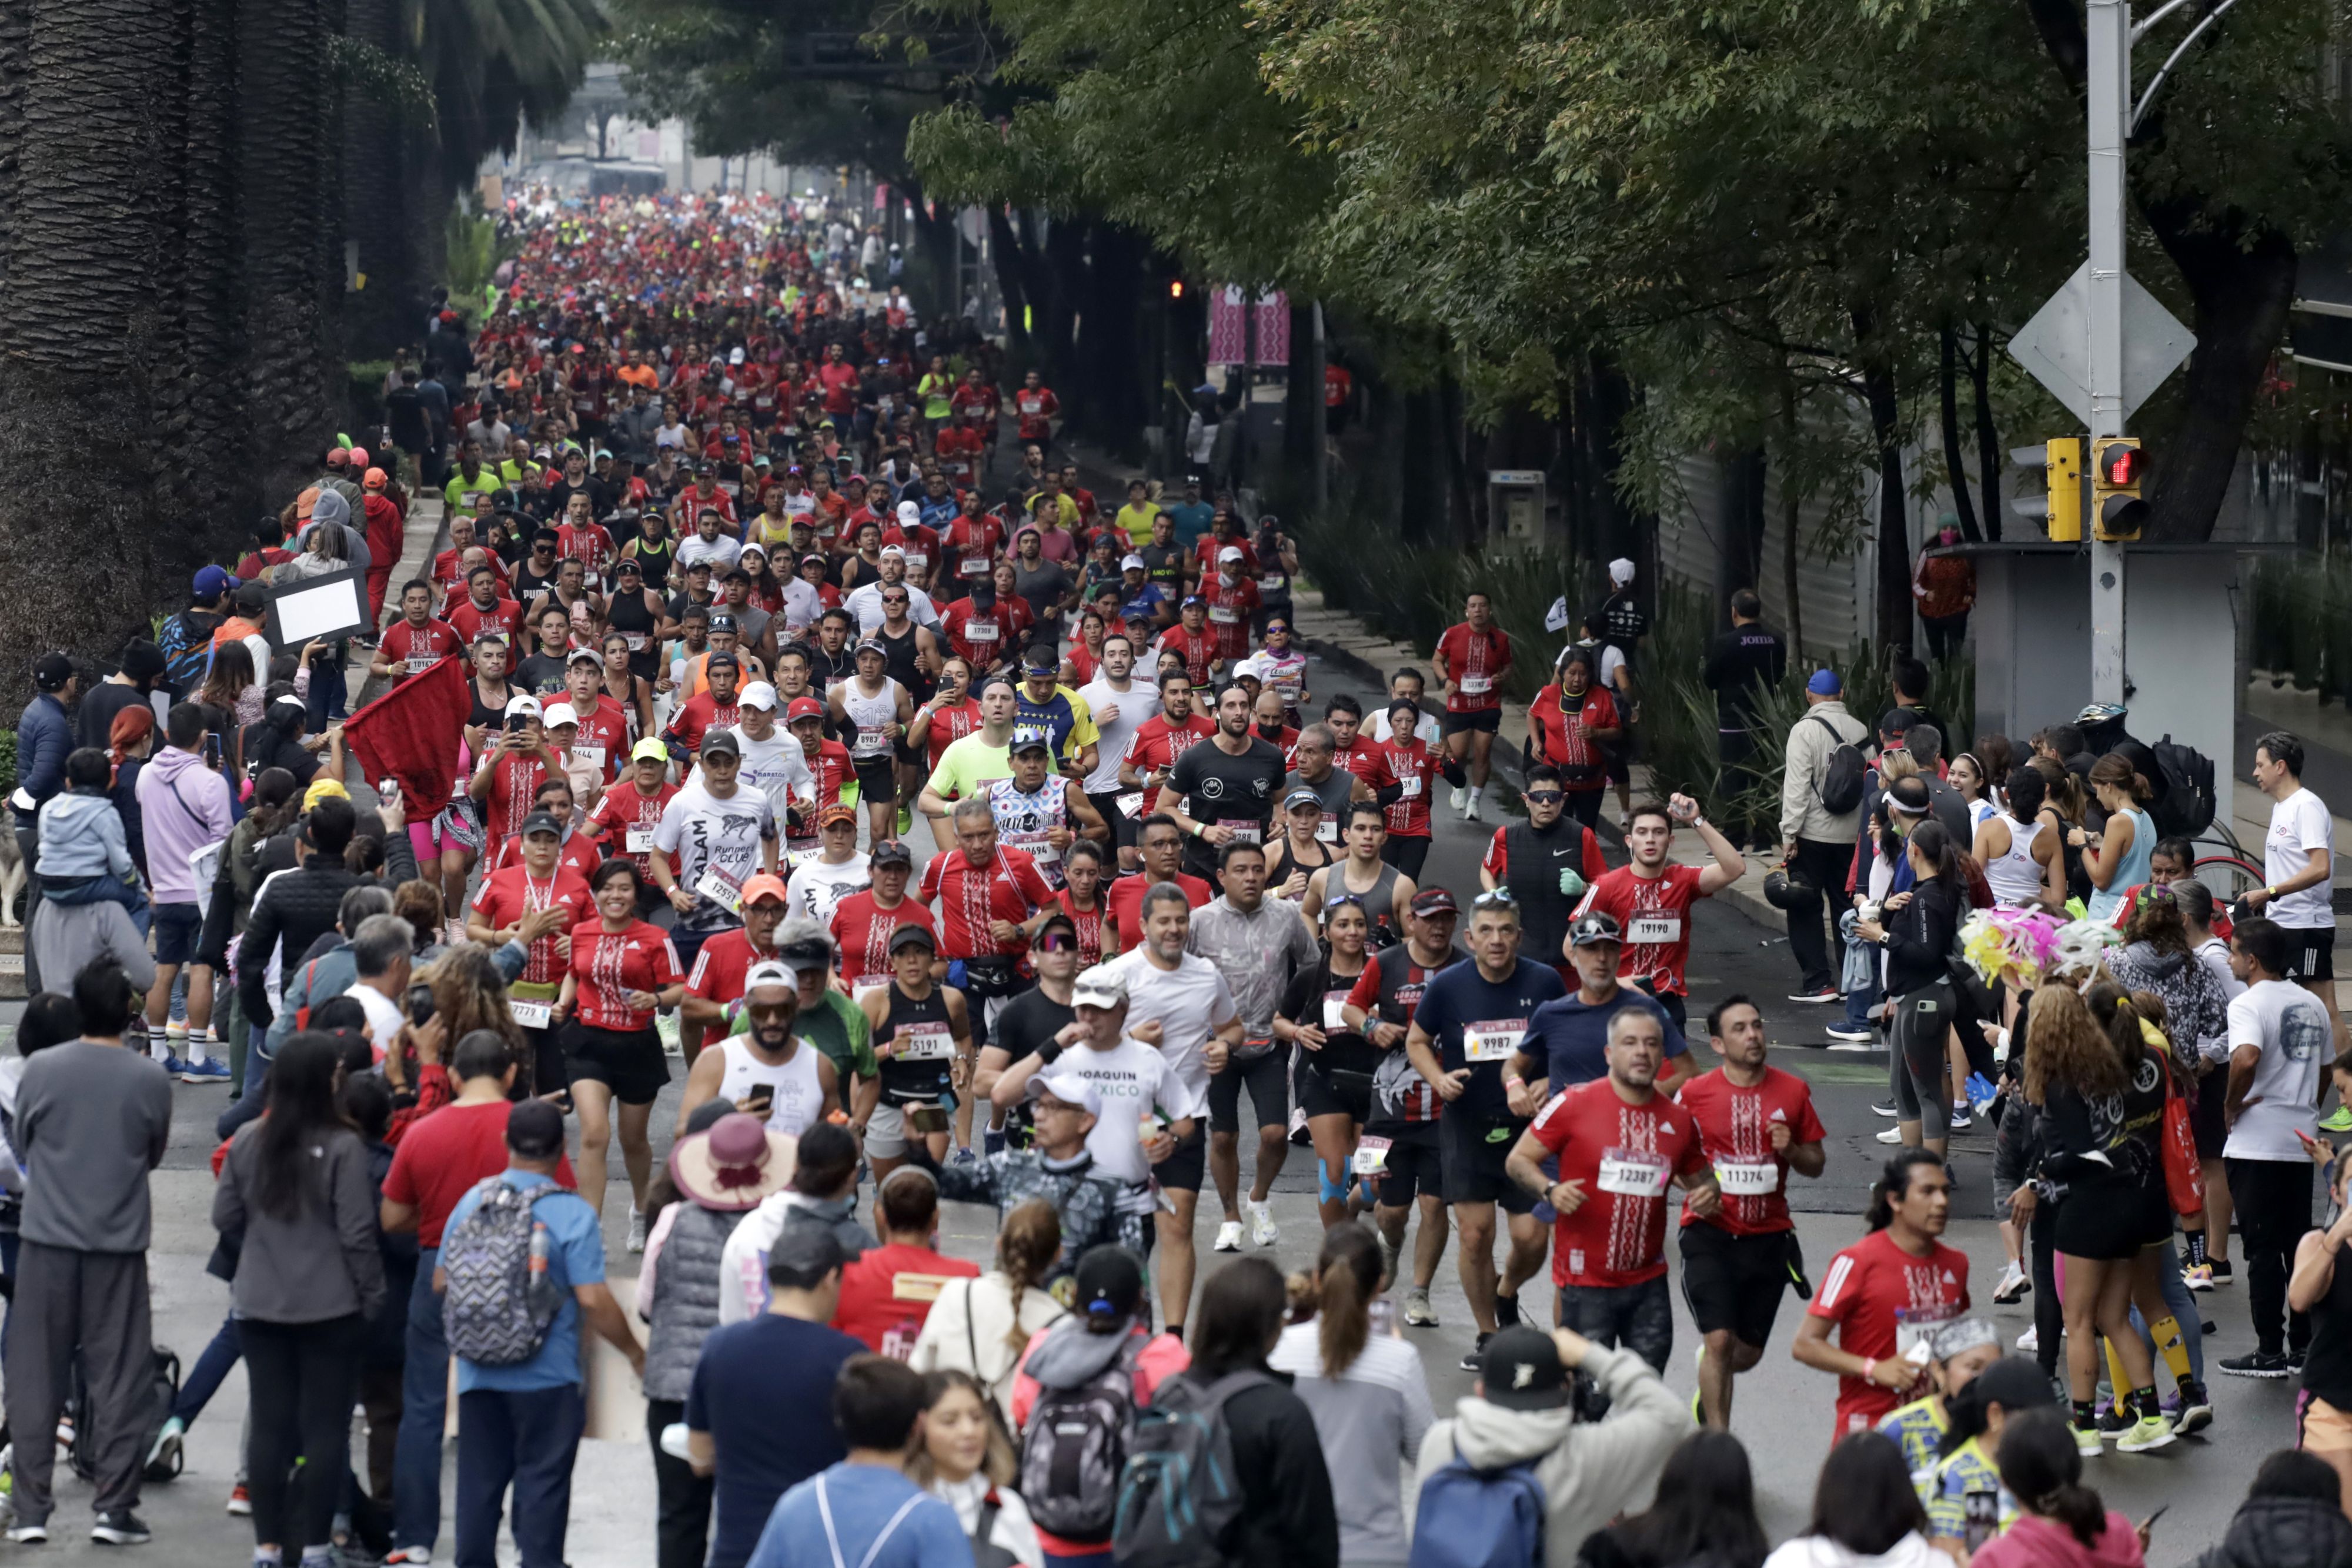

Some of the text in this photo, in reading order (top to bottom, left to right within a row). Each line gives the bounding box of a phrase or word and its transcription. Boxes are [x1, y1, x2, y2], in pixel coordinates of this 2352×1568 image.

[523, 590, 546, 599] PUM
[720, 851, 749, 863] CLUB
[1641, 924, 1669, 933] 19190
[1484, 1037, 1510, 1048] 9987
[1620, 1169, 1655, 1183] 12387
[1728, 1171, 1763, 1183] 11374
